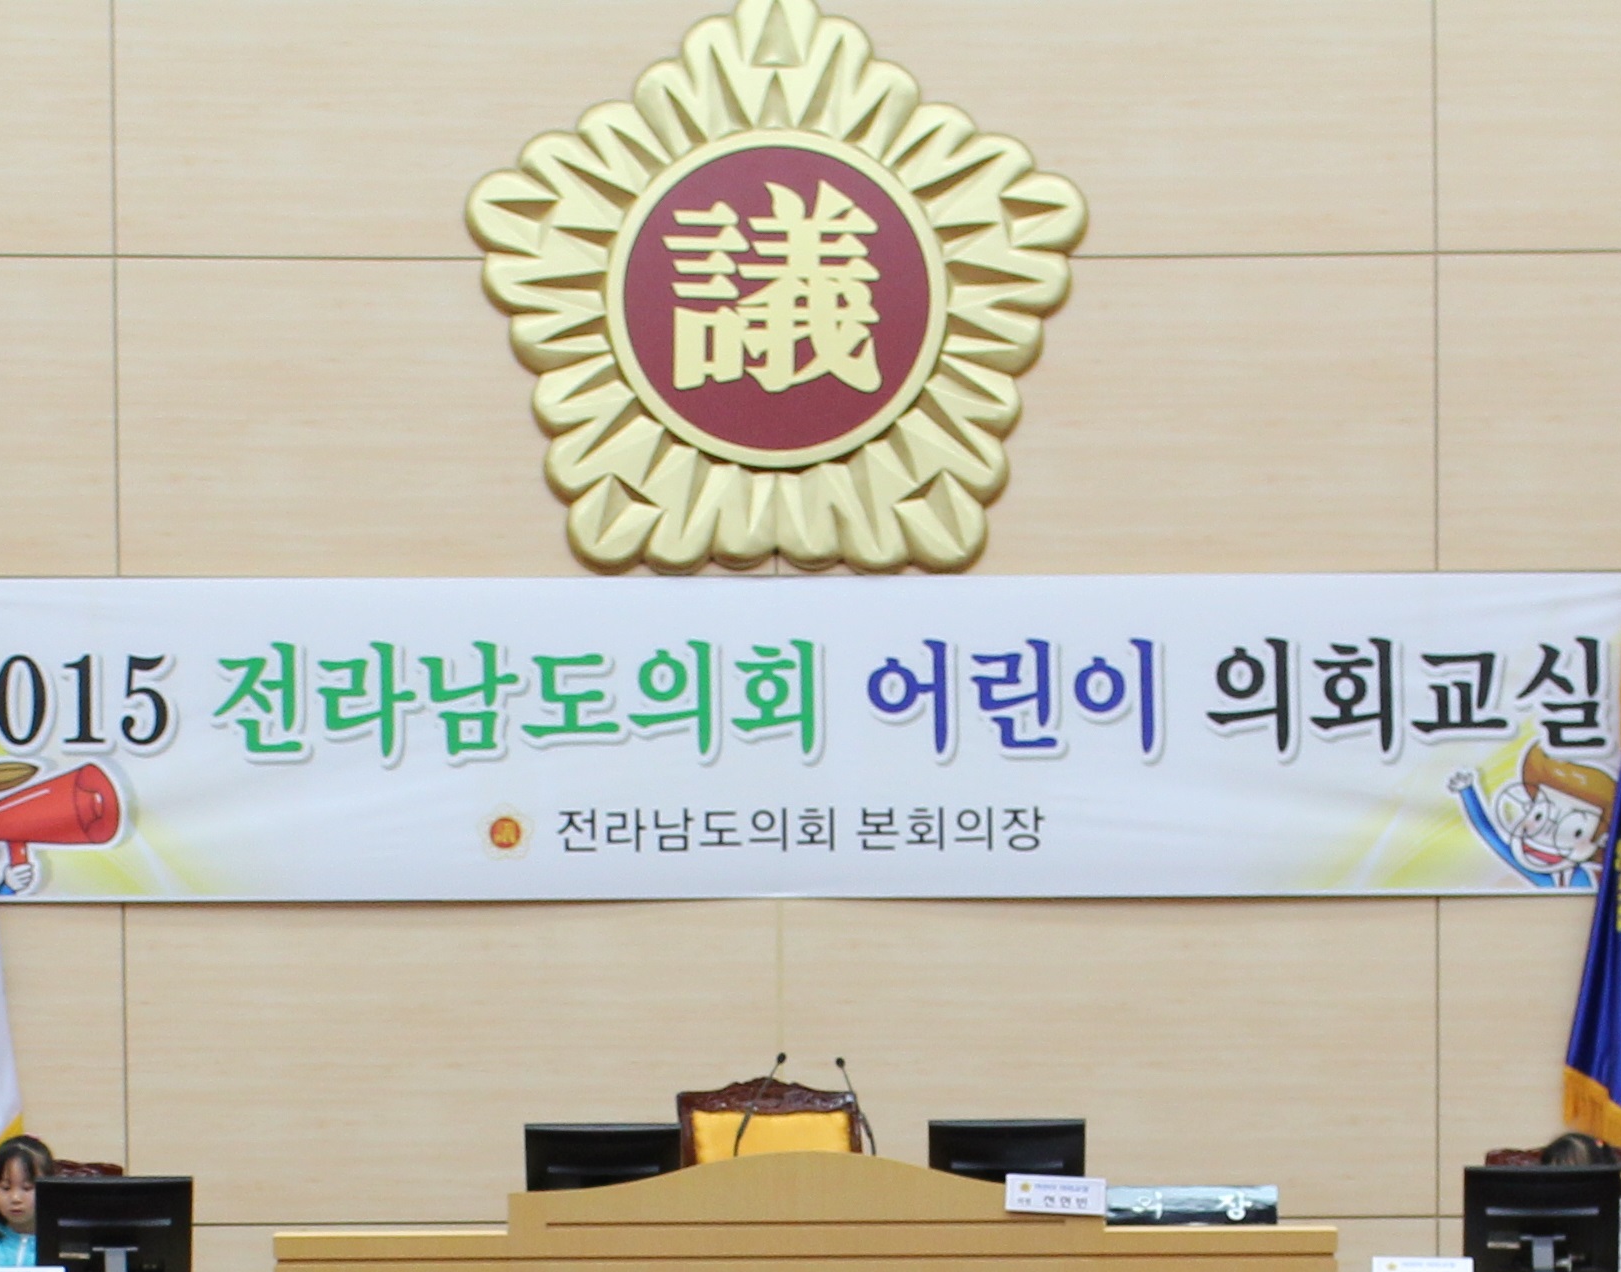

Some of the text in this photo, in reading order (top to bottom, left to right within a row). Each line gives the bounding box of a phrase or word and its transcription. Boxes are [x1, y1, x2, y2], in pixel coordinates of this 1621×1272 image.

[662, 179, 882, 393] 議
[215, 640, 816, 755] 전라남도의회
[866, 637, 1155, 754] 어린이
[1207, 637, 1611, 753] 의회교실
[556, 805, 1046, 852] 전라남도의회 본회의장
